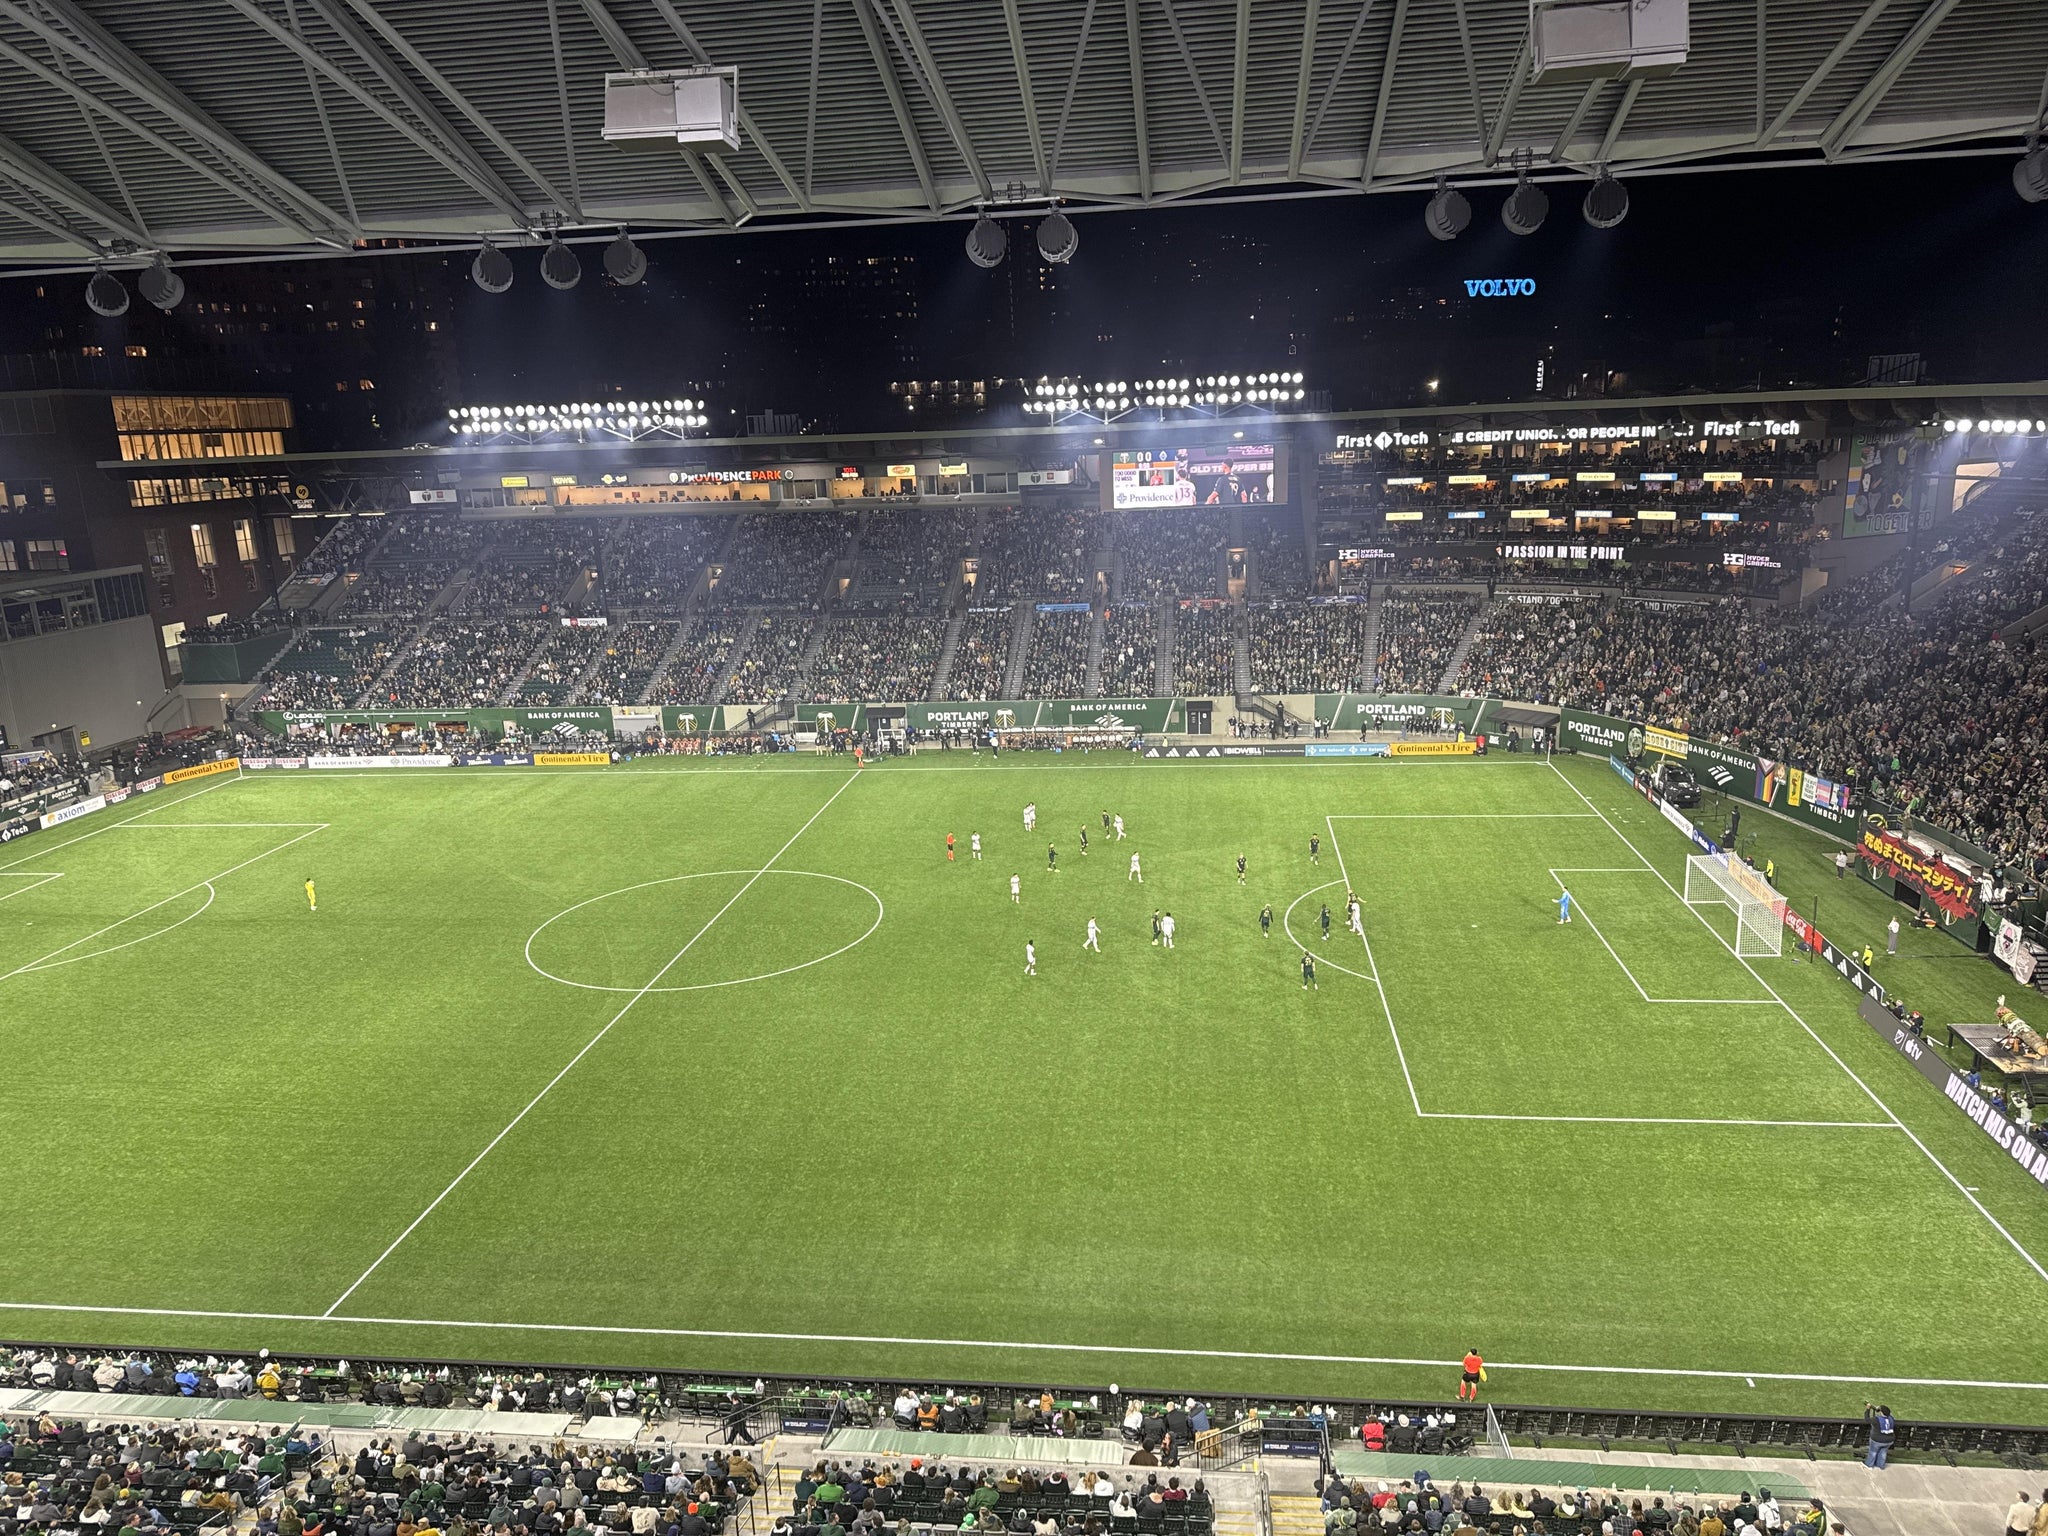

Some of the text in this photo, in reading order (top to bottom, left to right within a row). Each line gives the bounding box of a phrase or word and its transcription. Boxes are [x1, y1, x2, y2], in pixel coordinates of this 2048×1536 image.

[1464, 278, 1536, 297] VOLVO
[1466, 430, 1513, 443] CREDIT
[1561, 428, 1588, 439] OR
[1590, 426, 1640, 438] PEOPLE
[1642, 426, 1656, 438] IN
[1704, 421, 1742, 436] First
[1763, 420, 1800, 436] Tech
[1336, 434, 1372, 448] First
[1393, 431, 1428, 446] Tech
[1190, 466, 1211, 474] OLD
[1130, 493, 1174, 502] Providence
[1866, 511, 1933, 533] TOGETER
[1338, 548, 1358, 560] HG
[1506, 546, 1624, 560] PASSION IN THE PRINT
[1723, 553, 1744, 566] HG
[1517, 595, 1543, 604] STAND
[1070, 704, 1094, 712] BANK
[1357, 704, 1426, 715] PORTLAND
[528, 712, 550, 720] BANK
[928, 711, 989, 722] PORTLAND
[1372, 714, 1412, 722] TIMBERS
[1568, 720, 1625, 742] PORTLAND
[1580, 734, 1614, 748] TIMBERS
[1396, 744, 1470, 754] Continental Tire
[402, 758, 441, 766] Providence
[540, 754, 604, 764] Continental Tire
[1688, 744, 1756, 771] BANK OF AMERICA
[172, 760, 235, 782] Continental Tire
[136, 776, 160, 790] DISCOUNT
[51, 786, 78, 800] PORTLAND
[105, 787, 132, 800] DISCOUNT
[57, 804, 86, 822] axiom
[10, 825, 28, 836] Tech
[1944, 1072, 1990, 1126] WATCH
[1984, 1108, 2016, 1149] MLS
[2010, 1134, 2036, 1169] ON
